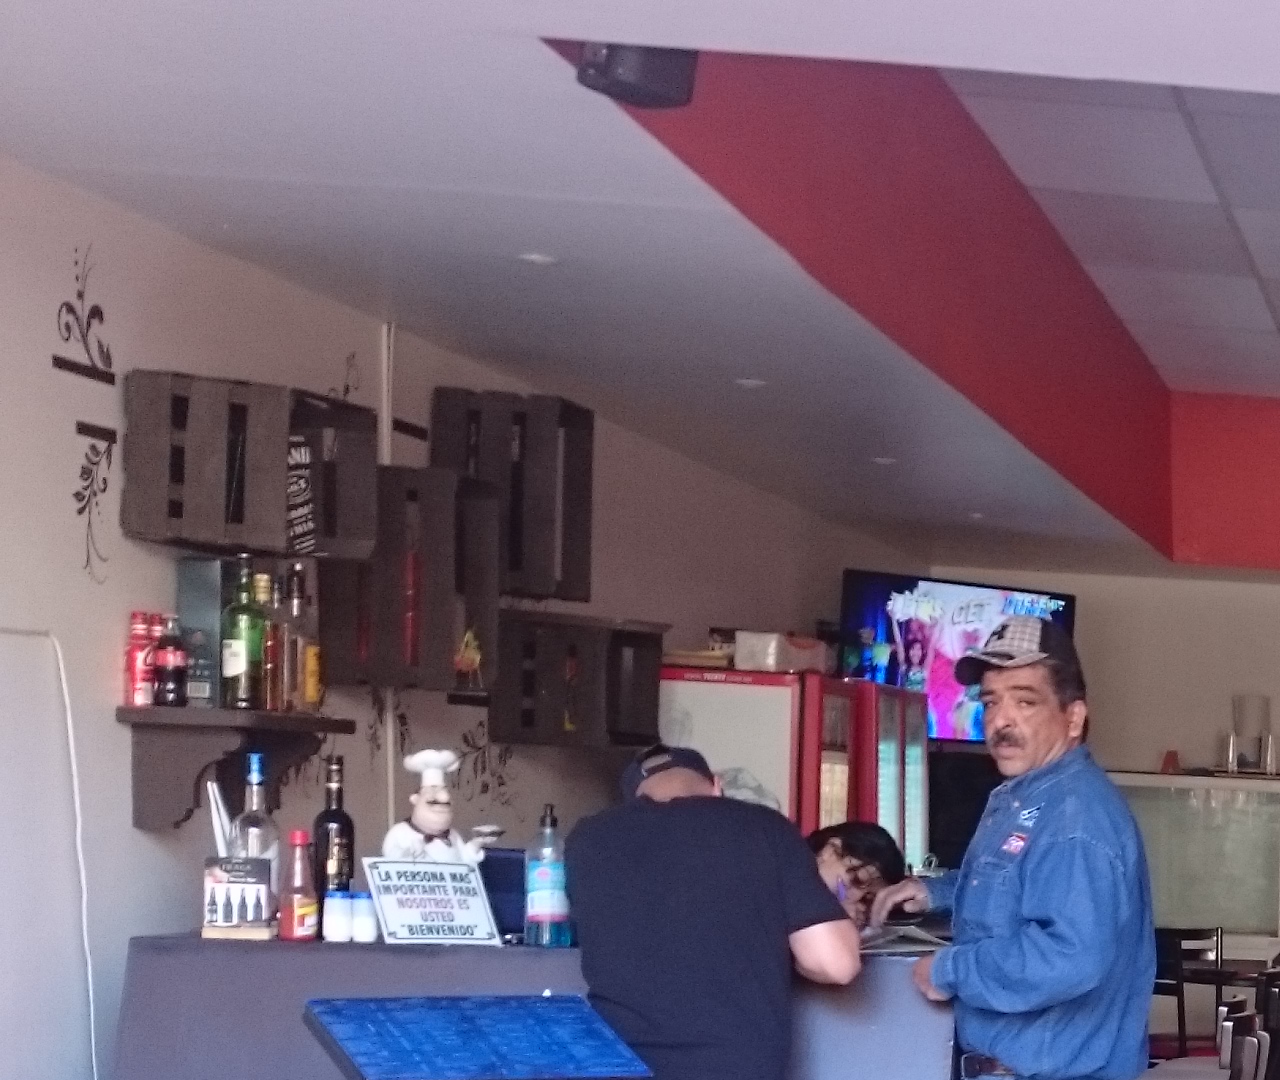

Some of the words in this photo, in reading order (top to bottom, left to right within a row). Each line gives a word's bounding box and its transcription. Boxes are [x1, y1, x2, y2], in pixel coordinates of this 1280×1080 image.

[378, 870, 392, 882] LA
[397, 870, 447, 883] PERSONA
[450, 872, 472, 884] MAS
[378, 884, 450, 896] IMPORTANTE
[453, 885, 478, 897] PARA
[396, 897, 455, 909] NOSOTROS
[457, 898, 470, 910] ES
[420, 911, 455, 923] USTED
